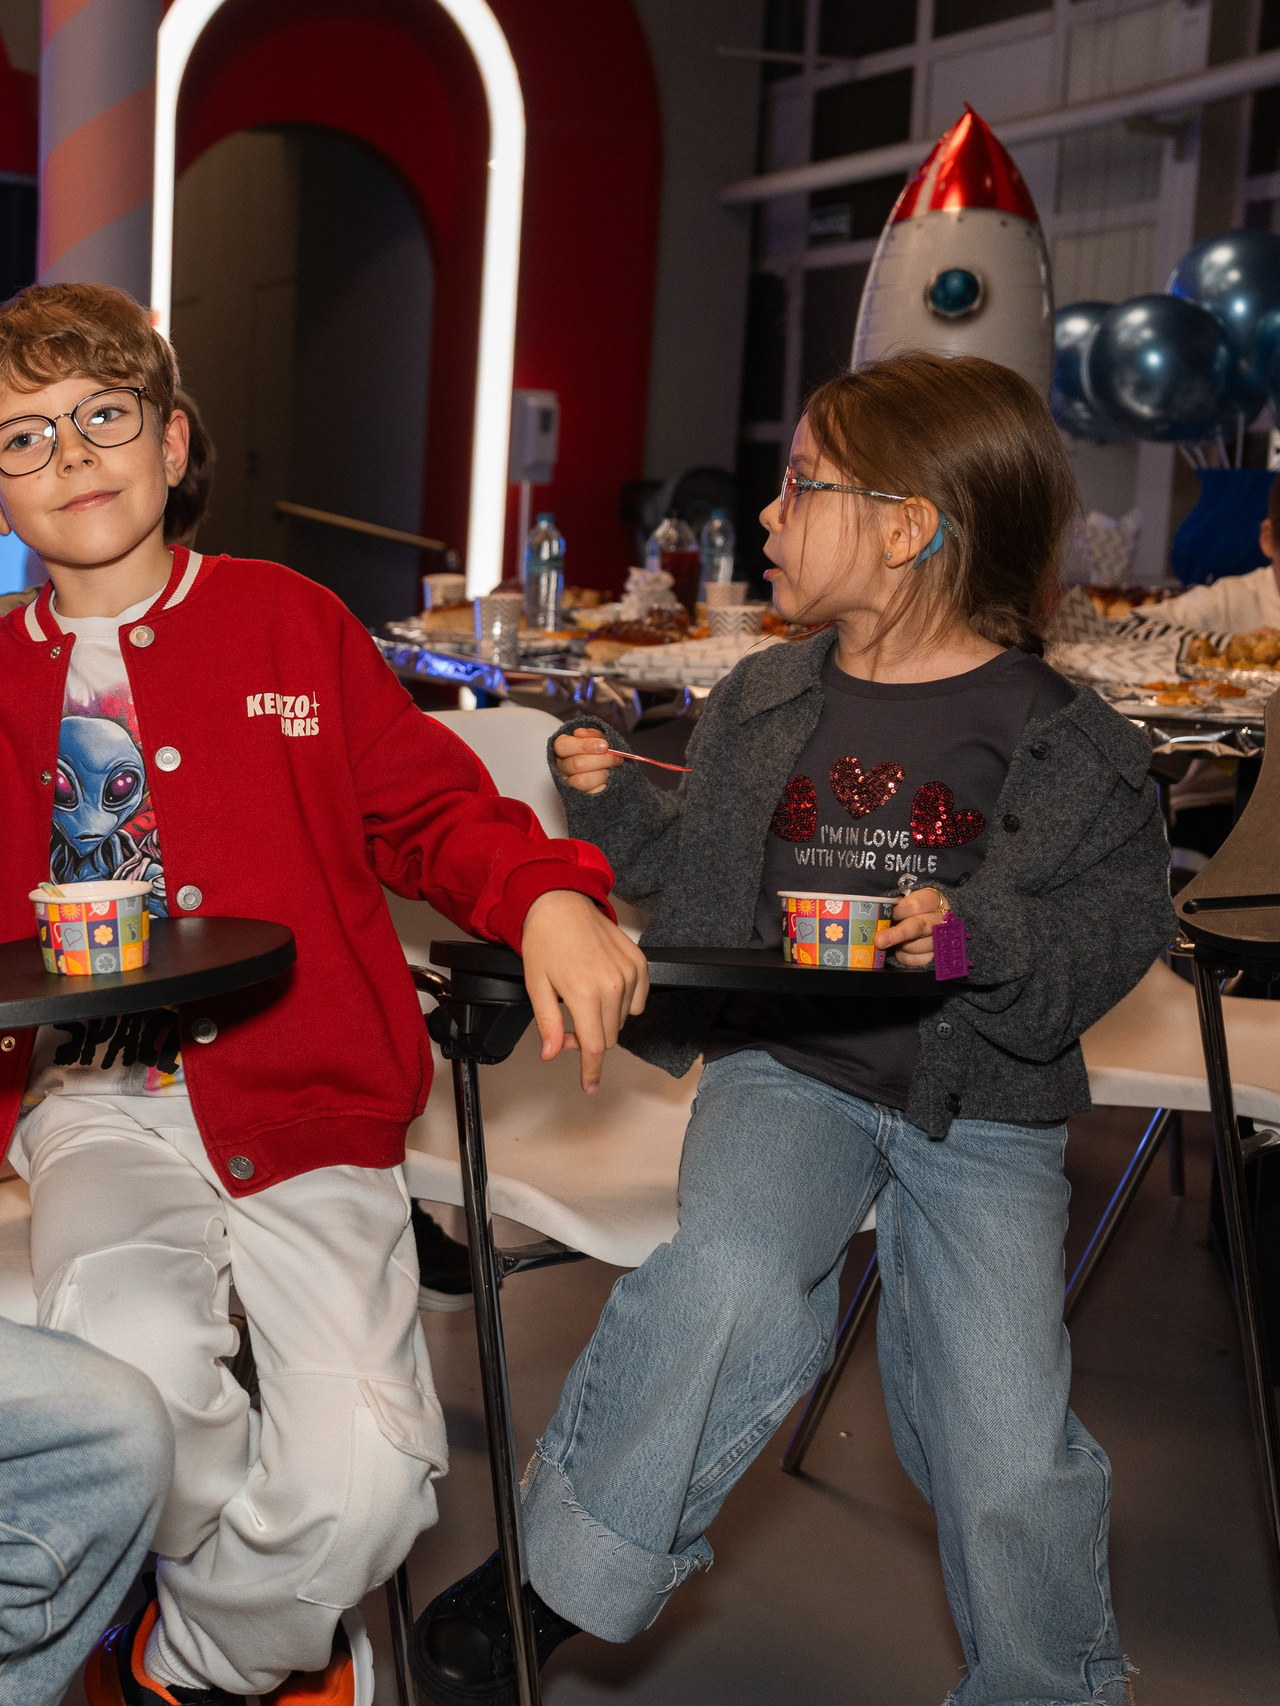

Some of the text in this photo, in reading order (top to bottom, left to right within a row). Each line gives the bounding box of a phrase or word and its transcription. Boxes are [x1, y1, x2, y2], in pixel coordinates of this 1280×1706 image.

[246, 692, 310, 718] KENZO
[280, 717, 320, 737] PARIS
[821, 824, 911, 850] I'M IN LOVE
[794, 847, 938, 874] WITH YOUR SMILE
